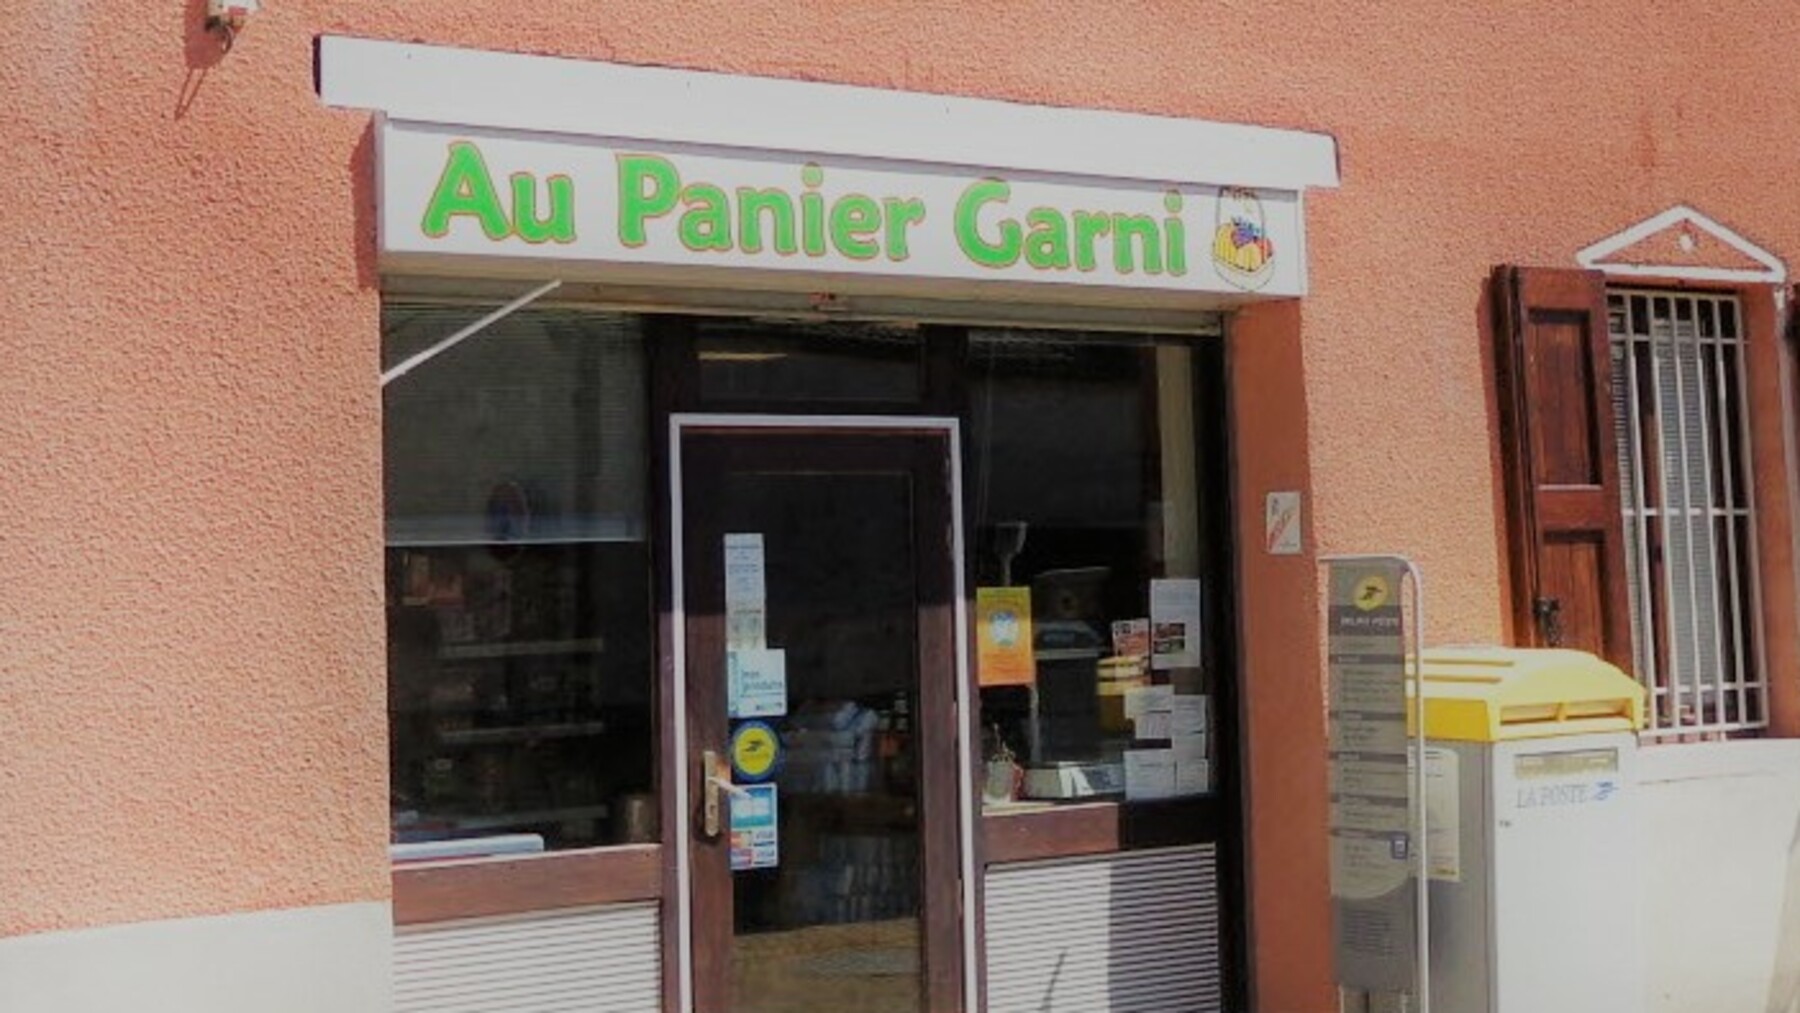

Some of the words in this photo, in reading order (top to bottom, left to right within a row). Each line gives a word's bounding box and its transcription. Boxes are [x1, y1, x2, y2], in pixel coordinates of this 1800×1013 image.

[421, 141, 575, 244] Au
[616, 153, 926, 264] Panier
[954, 178, 1188, 279] Garni
[1516, 787, 1537, 809] LA
[1539, 783, 1590, 807] POSTE
